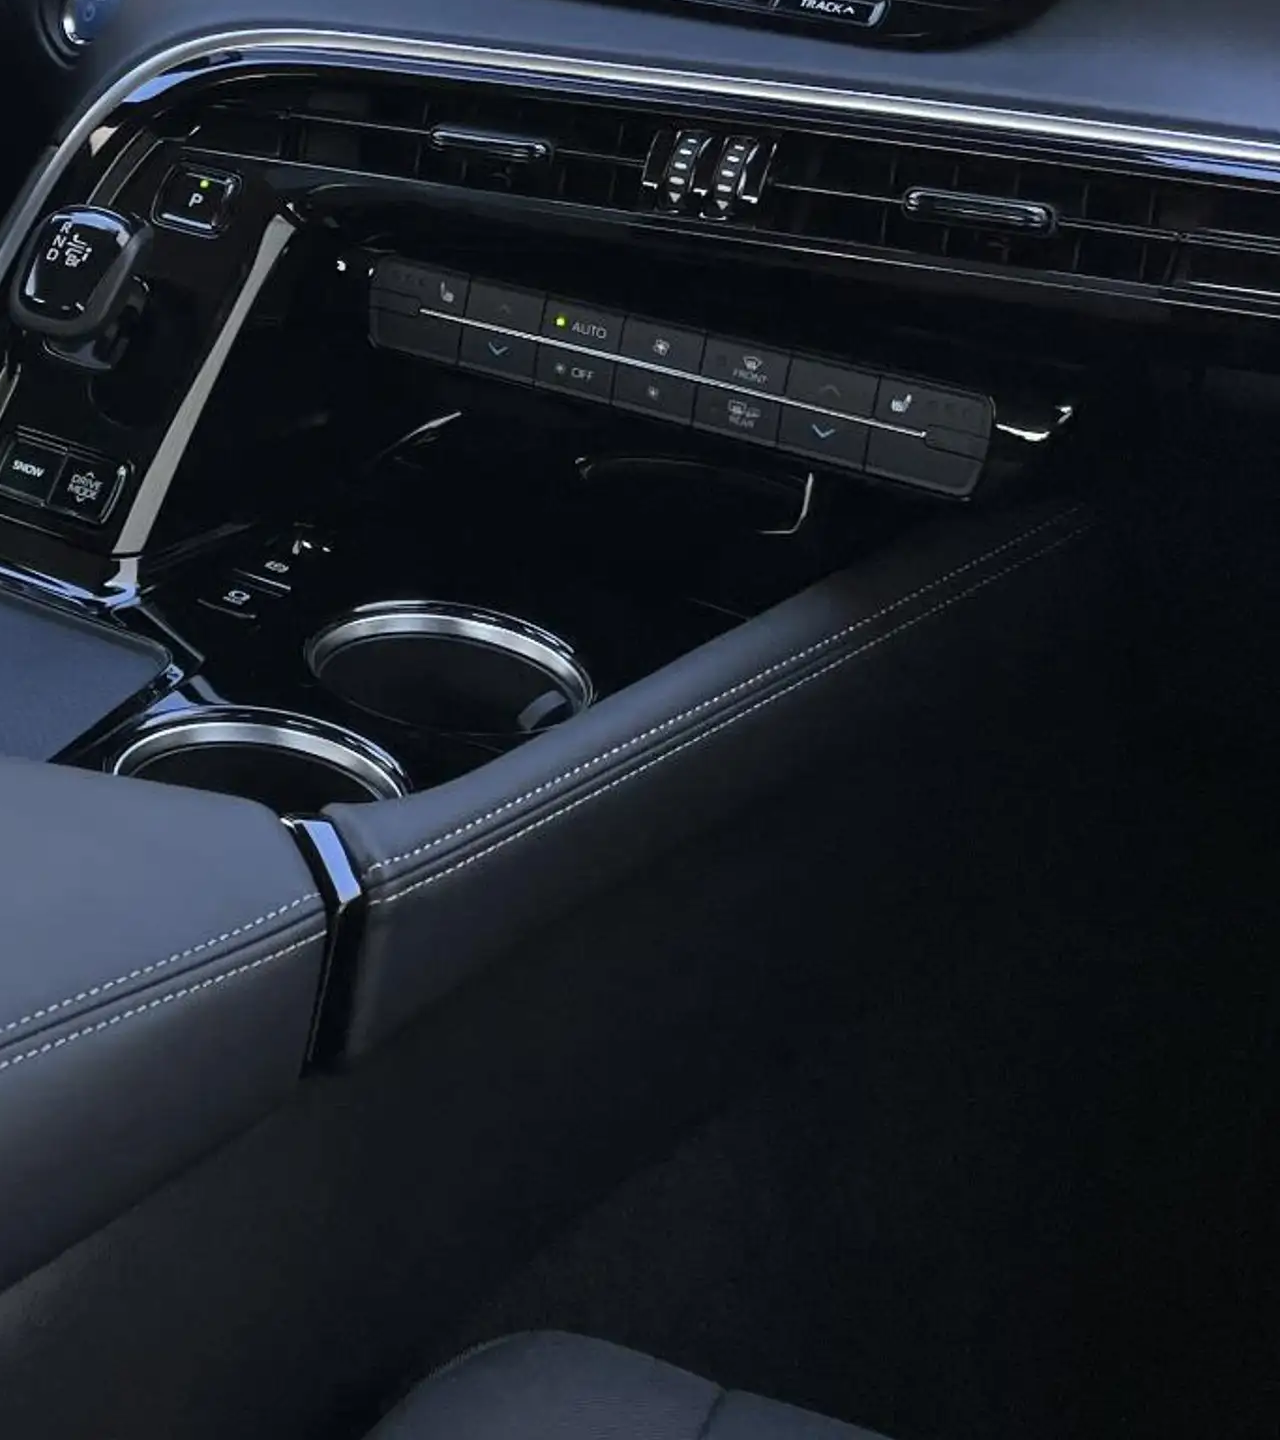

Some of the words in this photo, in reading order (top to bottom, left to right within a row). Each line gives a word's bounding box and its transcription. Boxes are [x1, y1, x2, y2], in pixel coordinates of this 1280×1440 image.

[188, 192, 204, 208] P
[60, 221, 73, 234] R
[52, 234, 67, 248] N
[46, 247, 60, 261] D
[571, 321, 608, 339] AUTO
[570, 367, 595, 381] OFF
[11, 459, 46, 478] SNOW
